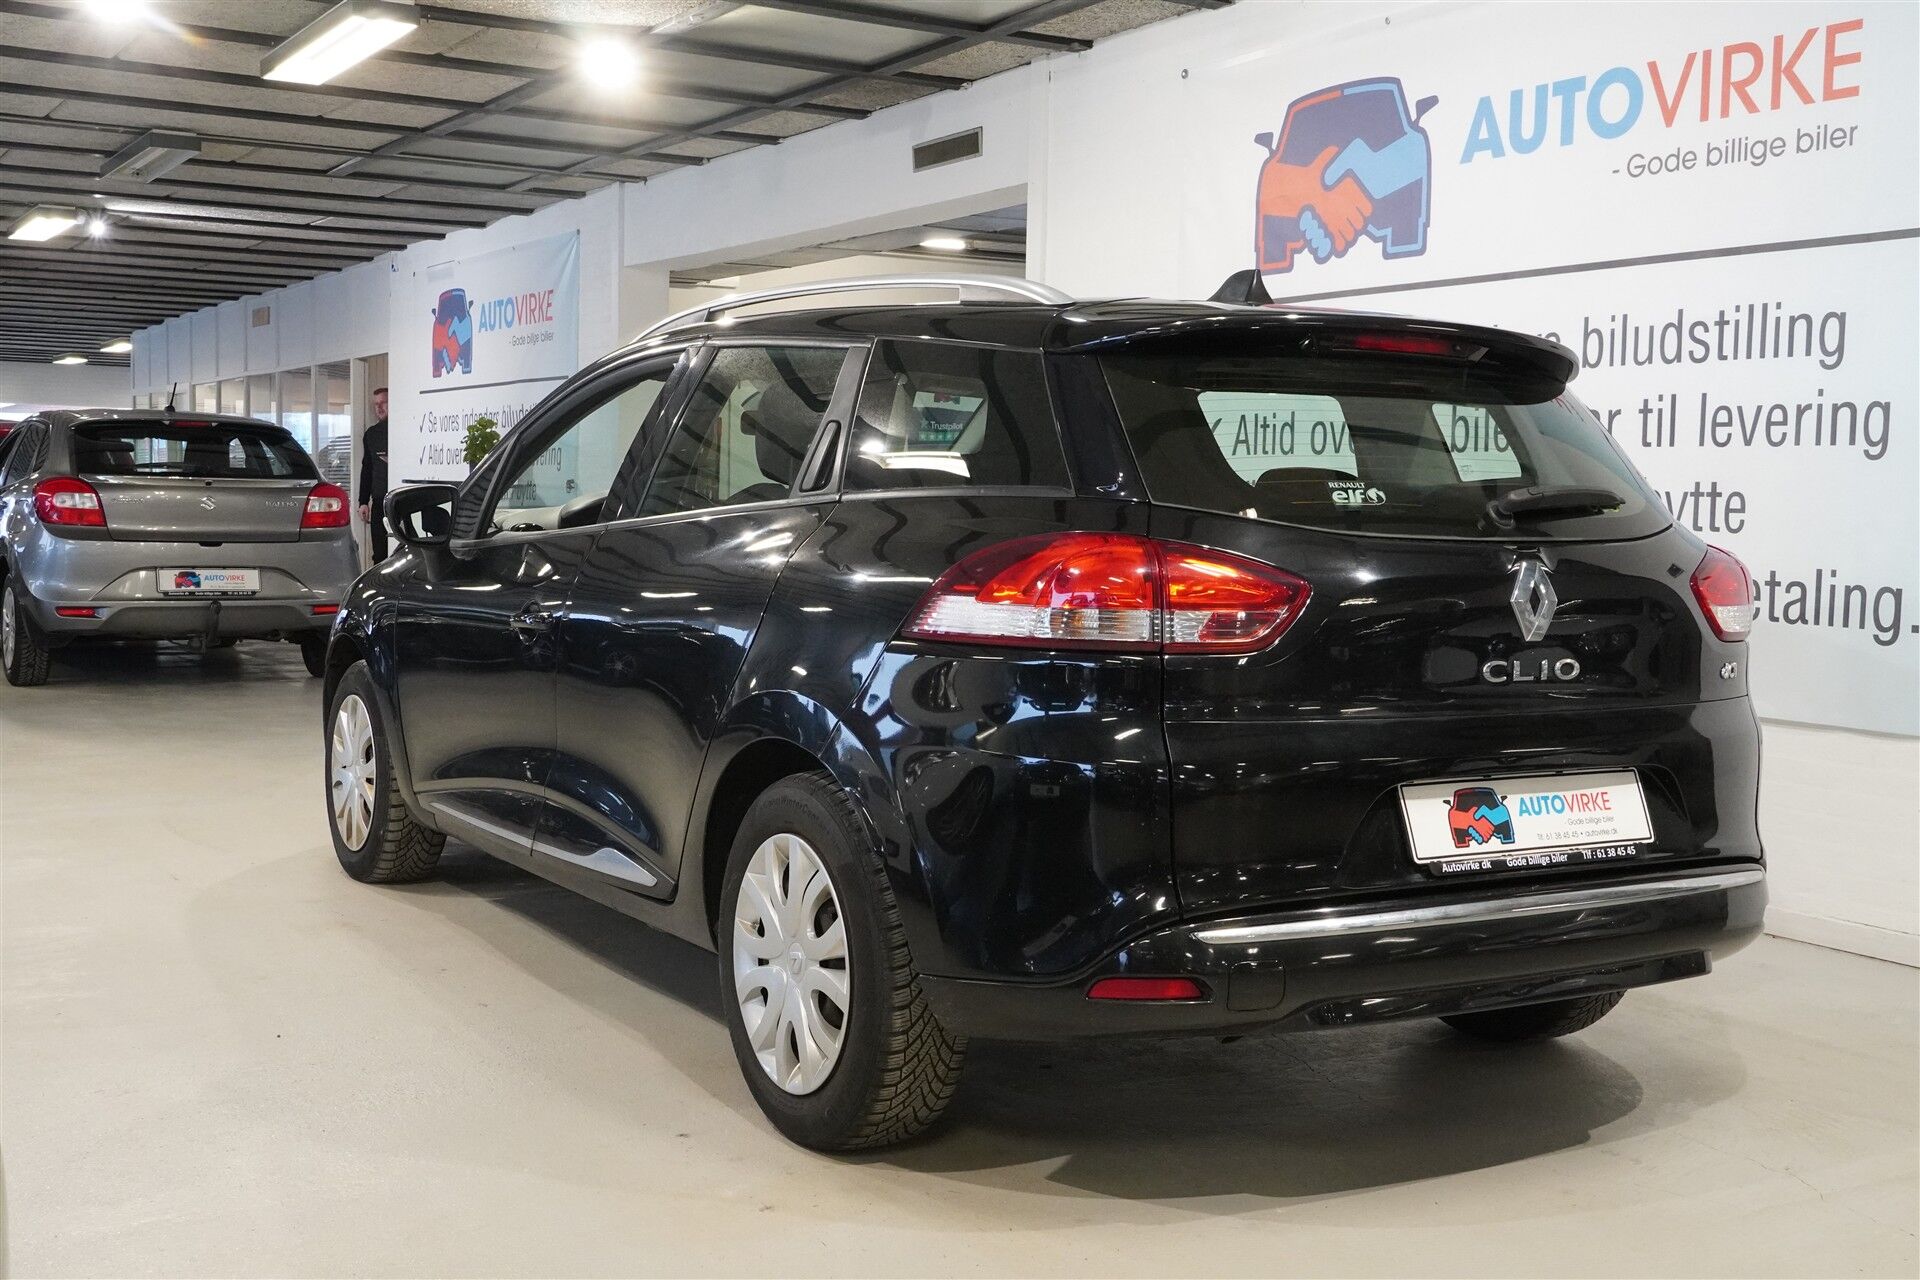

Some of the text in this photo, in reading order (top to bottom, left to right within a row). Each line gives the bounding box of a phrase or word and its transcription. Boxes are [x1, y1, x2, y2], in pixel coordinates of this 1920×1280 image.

[1460, 18, 1864, 164] AUTOVIRKE
[1626, 145, 1698, 178] Gode
[1706, 134, 1786, 168] billige
[1796, 125, 1858, 153] biler
[478, 289, 554, 333] AUTOVIRKE
[1581, 302, 1847, 370] biludstilling
[428, 411, 438, 433] Se
[439, 414, 459, 432] vores
[1231, 410, 1295, 456] Altid
[1310, 420, 1355, 456] ov
[1638, 393, 1677, 448] til
[1699, 388, 1891, 461] levering
[428, 443, 463, 465] Altid over
[1328, 482, 1366, 490] RENAULT
[1332, 489, 1367, 504] elf
[1482, 658, 1581, 683] CLIO
[1517, 791, 1613, 817] AUTOVIRKE
[1442, 860, 1480, 873] Autovirke
[1506, 856, 1528, 868] Gode
[1528, 854, 1551, 867] billige
[1551, 852, 1569, 863] biler
[1596, 849, 1606, 859] 61
[1607, 847, 1617, 858] 38
[1617, 846, 1626, 856] 45
[1626, 845, 1636, 856] 45
